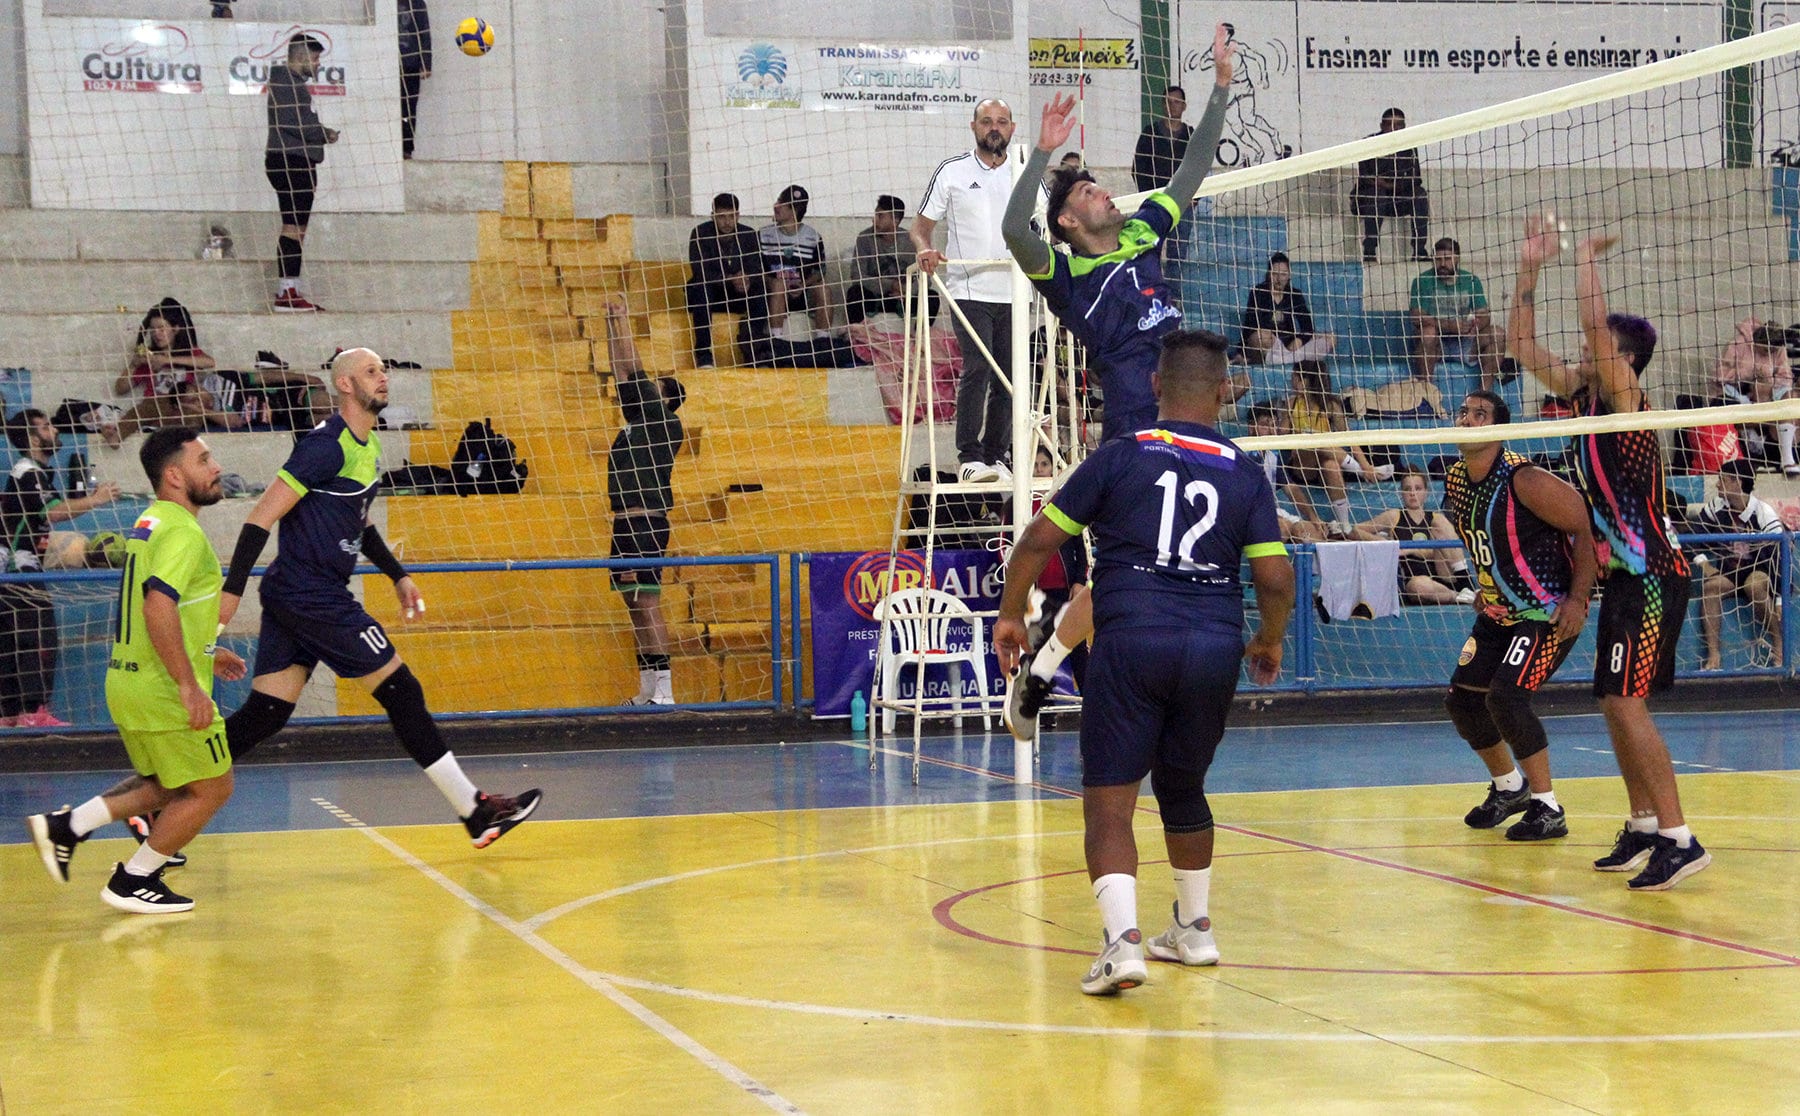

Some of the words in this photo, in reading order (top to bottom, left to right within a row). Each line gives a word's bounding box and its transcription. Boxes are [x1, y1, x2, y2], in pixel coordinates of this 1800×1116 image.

[82, 53, 201, 82] Cultura
[947, 50, 980, 61] VIVO
[1306, 36, 1391, 68] Ensinar
[1404, 49, 1439, 67] um
[1447, 36, 1541, 73] esporte
[1546, 41, 1557, 67] é
[1565, 36, 1642, 67] ensinar
[822, 90, 977, 103] www.karandafm.com.br
[1126, 266, 1140, 290] 7
[1155, 470, 1220, 571] 12
[1466, 529, 1492, 566] 16
[115, 552, 136, 645] 11
[360, 625, 388, 655] 10
[1502, 636, 1530, 667] 16
[1610, 642, 1624, 674] 8
[205, 733, 226, 764] 11
